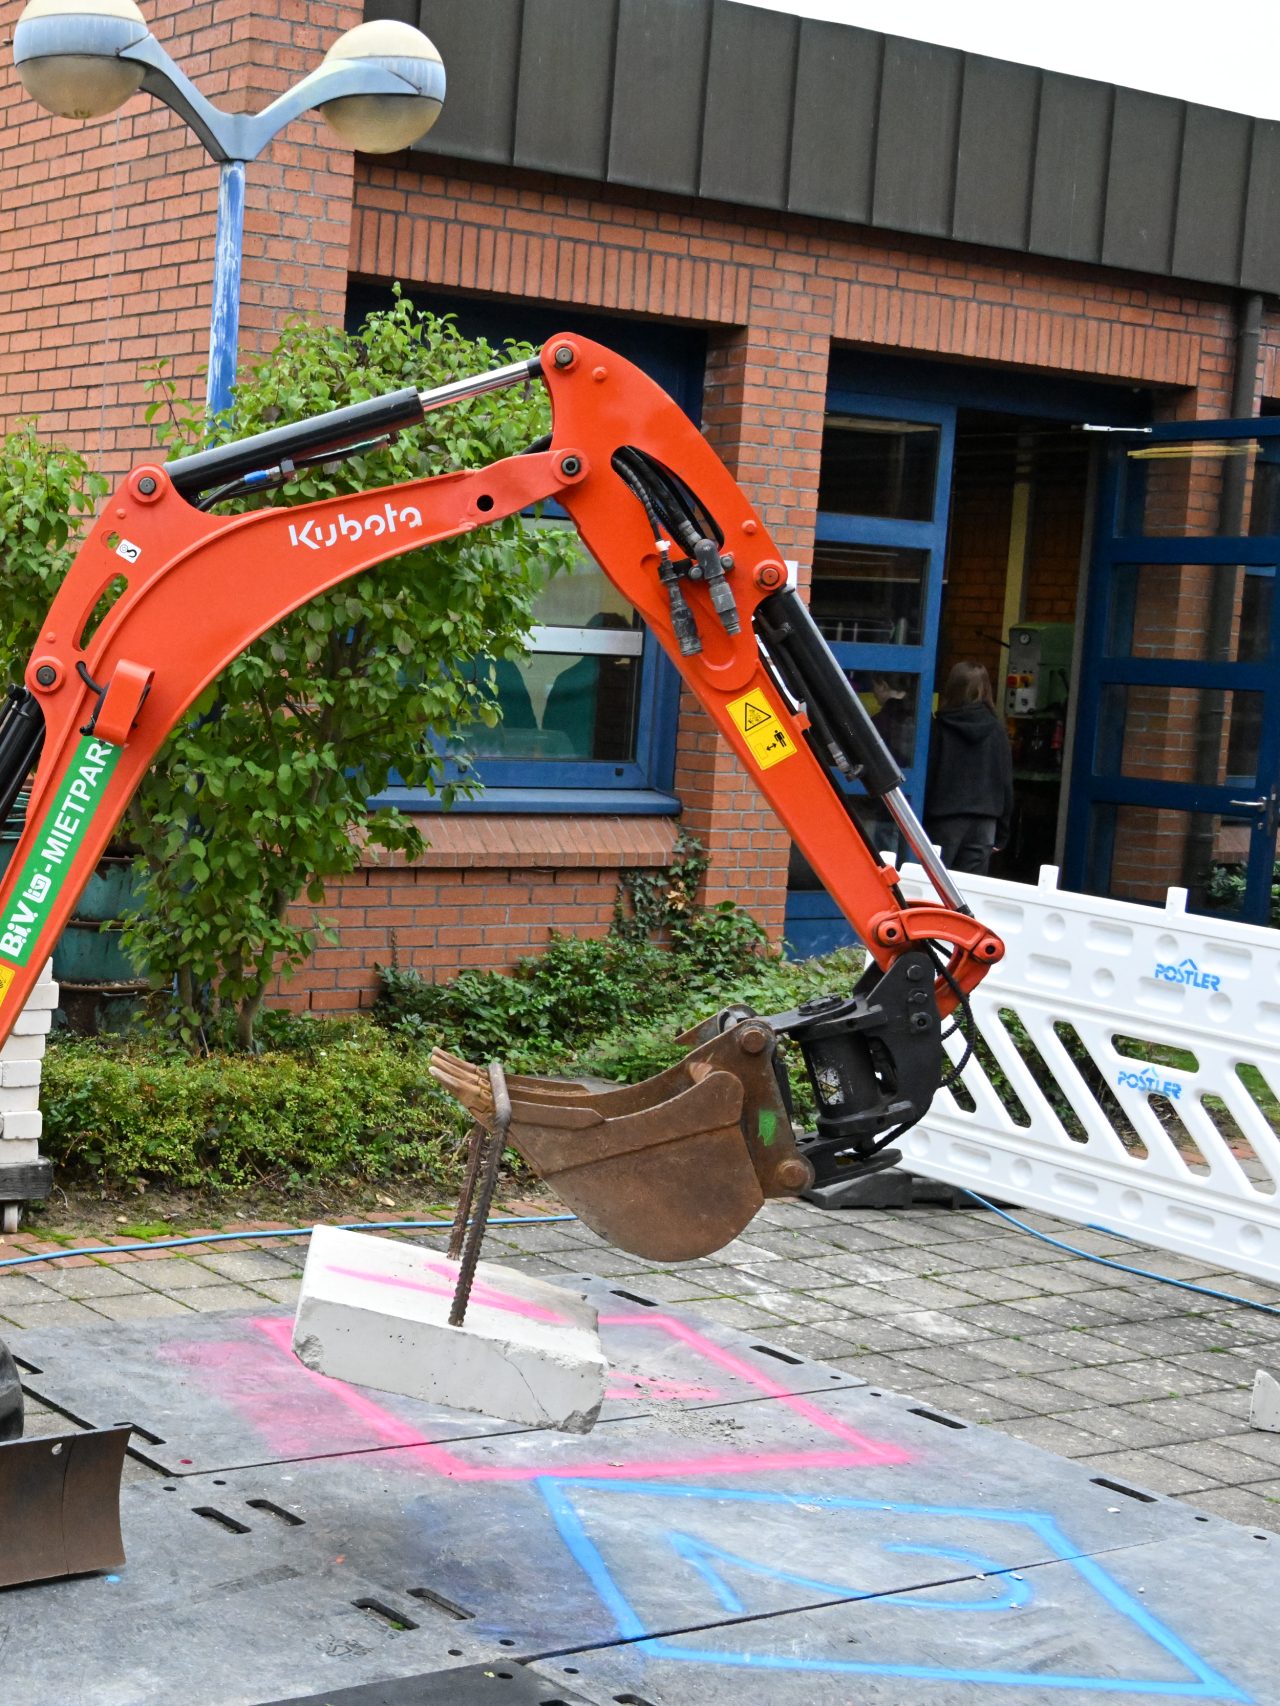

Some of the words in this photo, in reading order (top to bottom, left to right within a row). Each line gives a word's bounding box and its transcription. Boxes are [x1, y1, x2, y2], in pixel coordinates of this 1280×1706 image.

[288, 503, 423, 550] Kubota
[40, 738, 115, 865] MIETPAR
[1154, 963, 1221, 992] POSTLER
[1117, 1070, 1182, 1100] POSTLER
